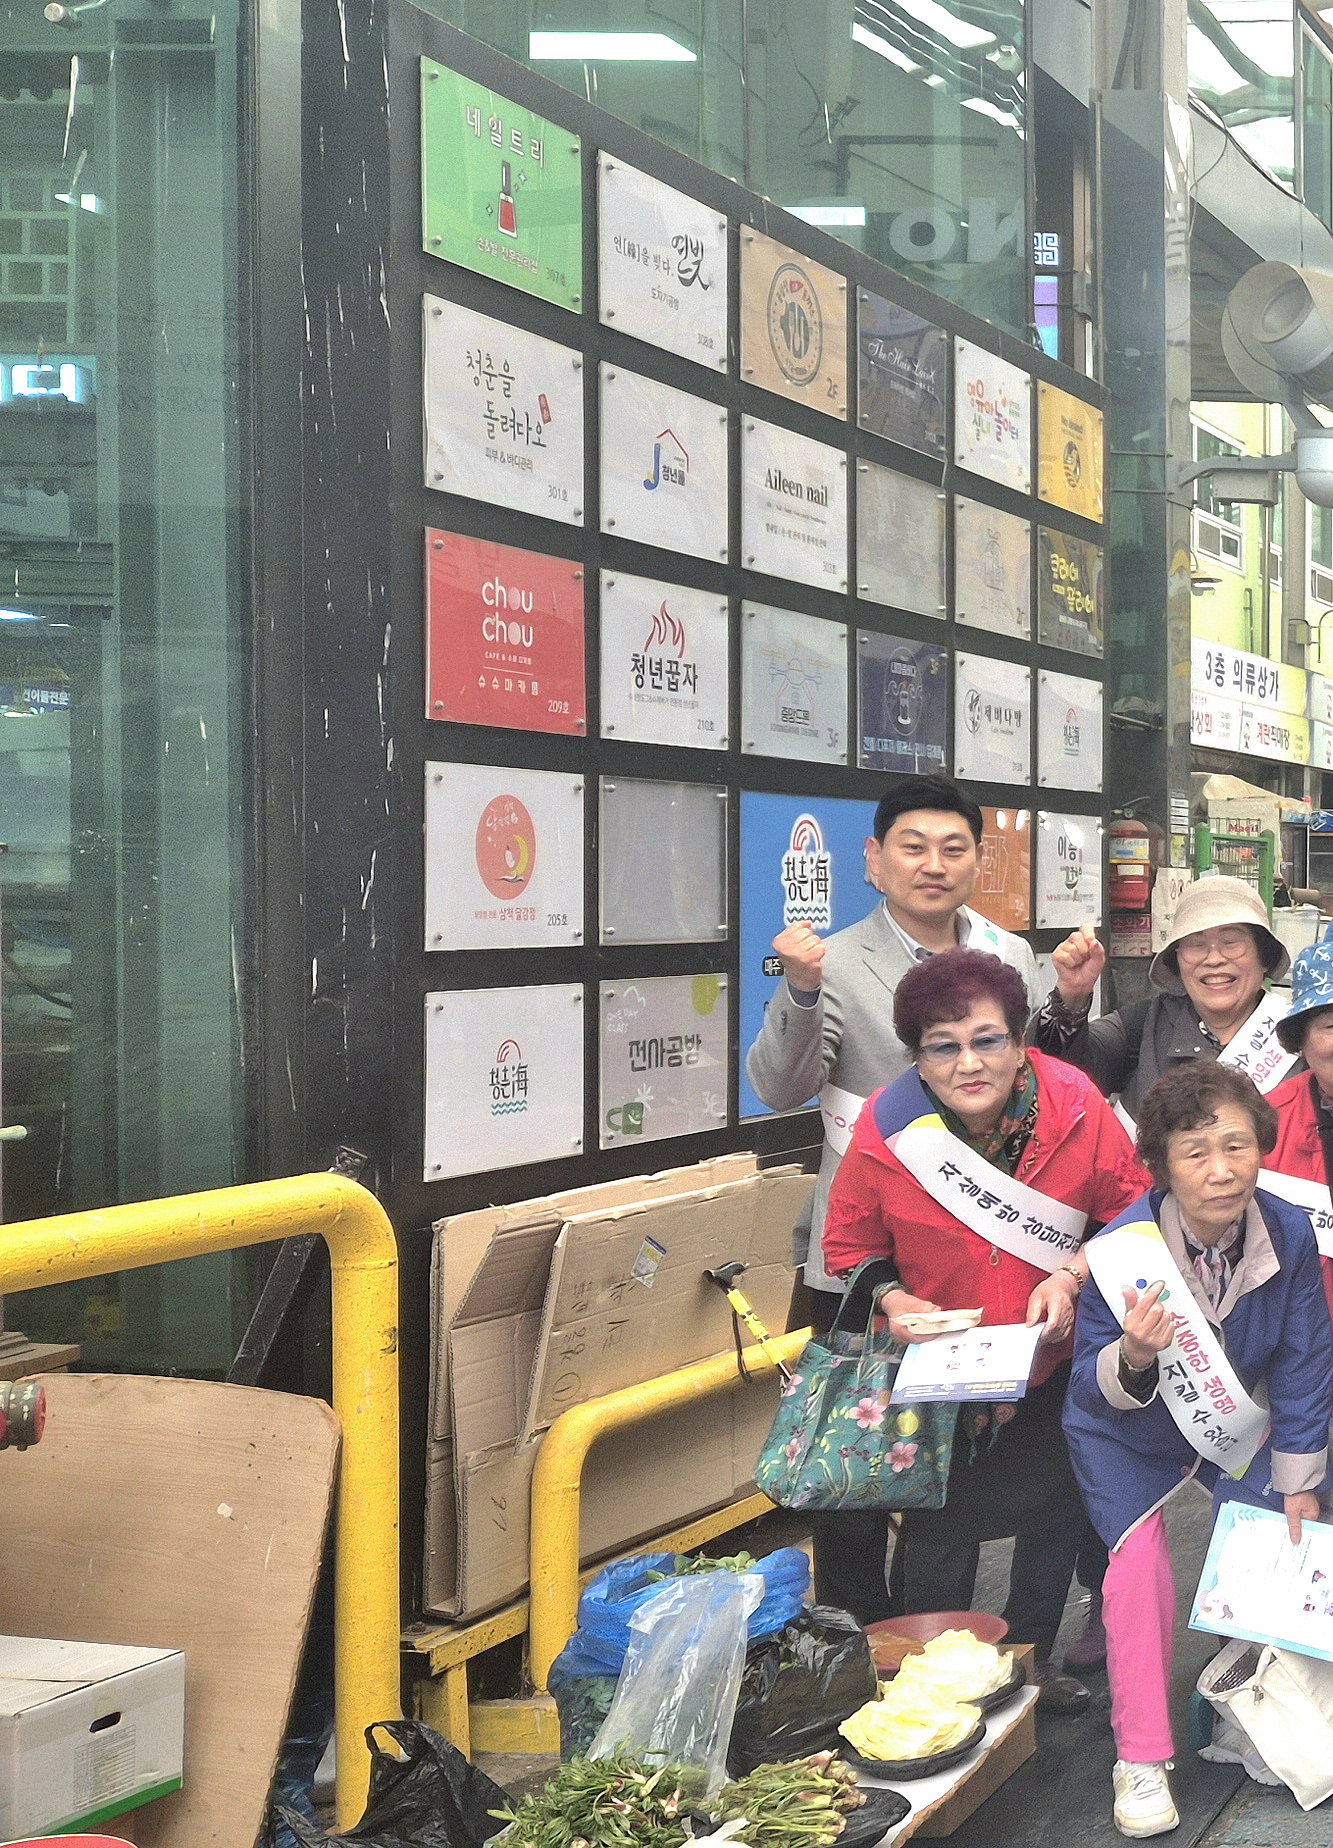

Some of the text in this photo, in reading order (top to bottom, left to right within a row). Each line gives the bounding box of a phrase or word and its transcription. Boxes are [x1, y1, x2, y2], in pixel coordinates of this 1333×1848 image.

[466, 349, 516, 399] 청춘을
[482, 399, 548, 448] 돌려다오
[765, 467, 829, 508] Aileen nail
[481, 576, 533, 613] chou
[481, 611, 534, 648] chou
[1206, 650, 1280, 702] 3층 의류상가
[547, 699, 570, 714] 209호
[547, 913, 568, 926] 205호
[628, 1033, 702, 1073] 전사공방
[937, 1160, 1021, 1224] 자살예방
[1162, 1360, 1213, 1426] 지킬 수
[1203, 1376, 1238, 1416] 생명
